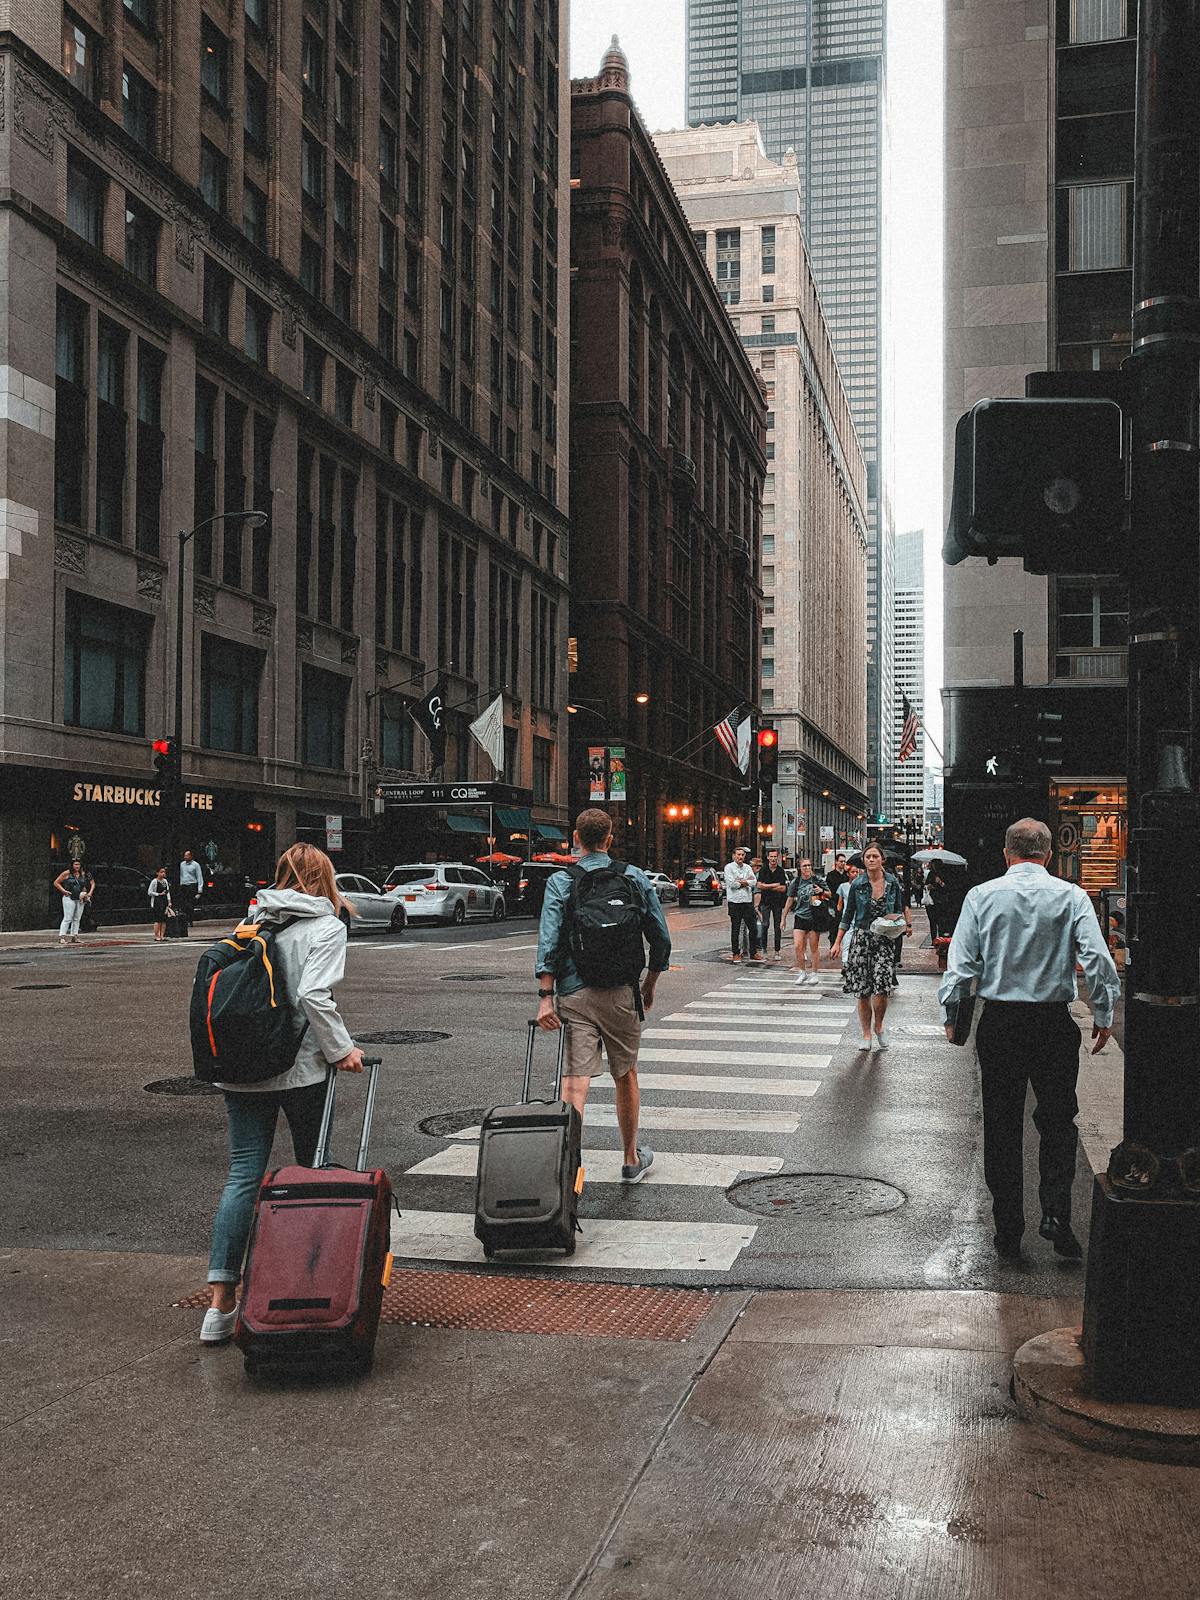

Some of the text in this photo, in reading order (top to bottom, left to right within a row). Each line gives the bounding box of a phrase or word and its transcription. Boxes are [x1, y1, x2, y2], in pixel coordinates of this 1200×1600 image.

[73, 783, 213, 811] STARBUCKS FFEE
[431, 790, 444, 798] 111
[450, 788, 468, 799] CQ
